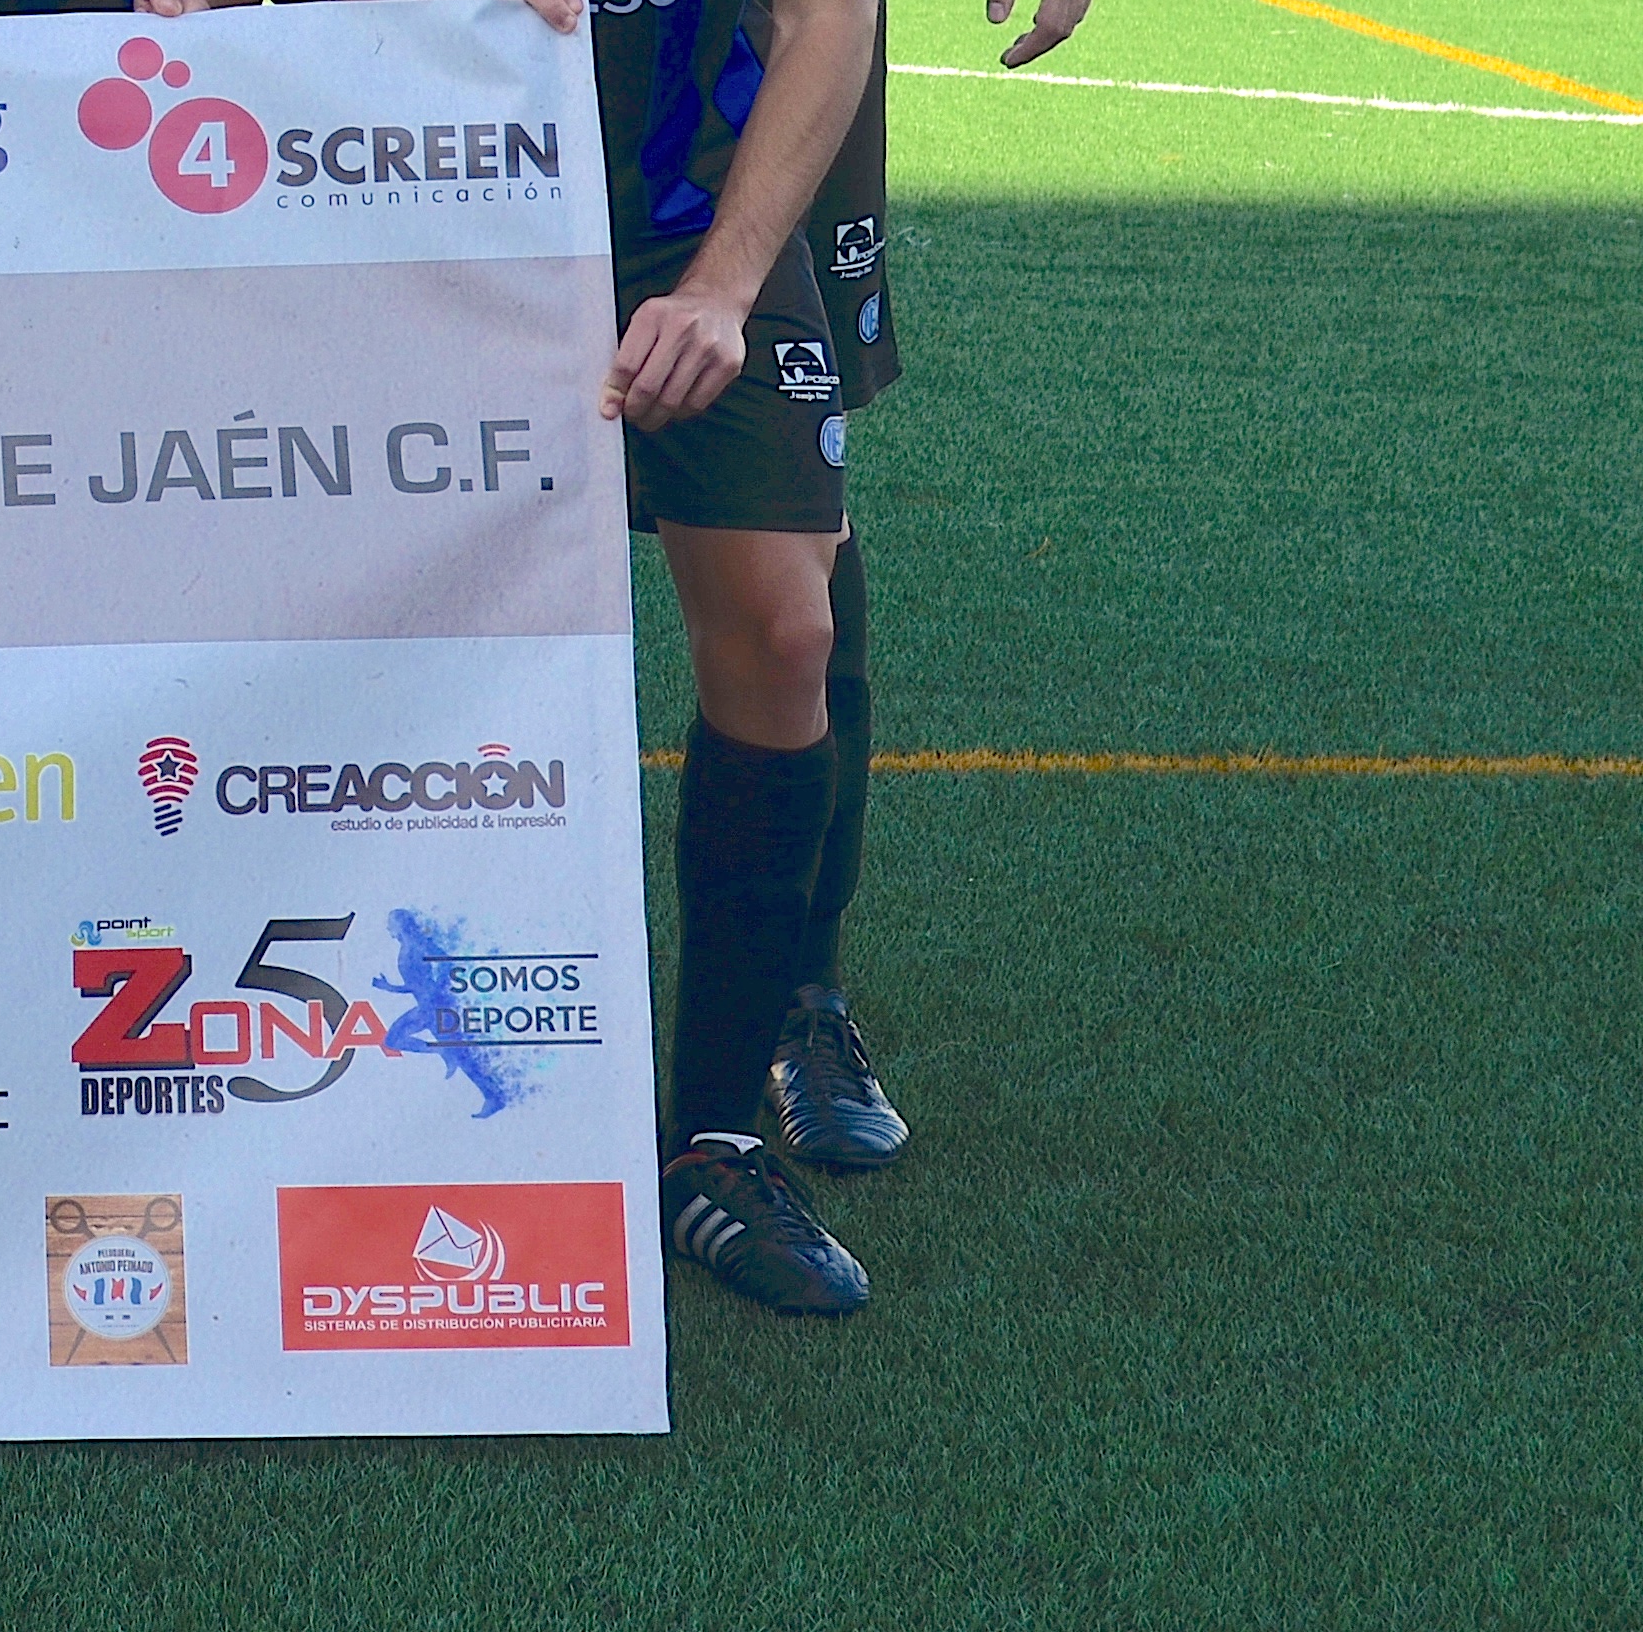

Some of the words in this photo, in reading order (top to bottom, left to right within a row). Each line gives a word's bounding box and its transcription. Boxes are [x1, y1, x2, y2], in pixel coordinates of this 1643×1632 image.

[177, 120, 236, 188] 4
[275, 121, 561, 187] SCREEN
[276, 182, 563, 209] comunicación
[88, 409, 353, 504] JAÉN
[385, 417, 555, 494] C.F.
[331, 816, 381, 831] estudio
[385, 816, 403, 831] de
[407, 814, 478, 833] publicidad
[97, 916, 151, 932] point
[448, 962, 582, 994] SOMOS
[435, 1004, 599, 1035] DEPORTE
[80, 1075, 226, 1116] DEPORTES
[303, 1282, 605, 1317] DYSPUBLIC
[303, 1318, 375, 1332] SISTEMAS
[379, 1318, 399, 1331] DE
[402, 1315, 505, 1331] DISTRIBUCIÓN
[508, 1315, 608, 1329] PUBLICITARIA
